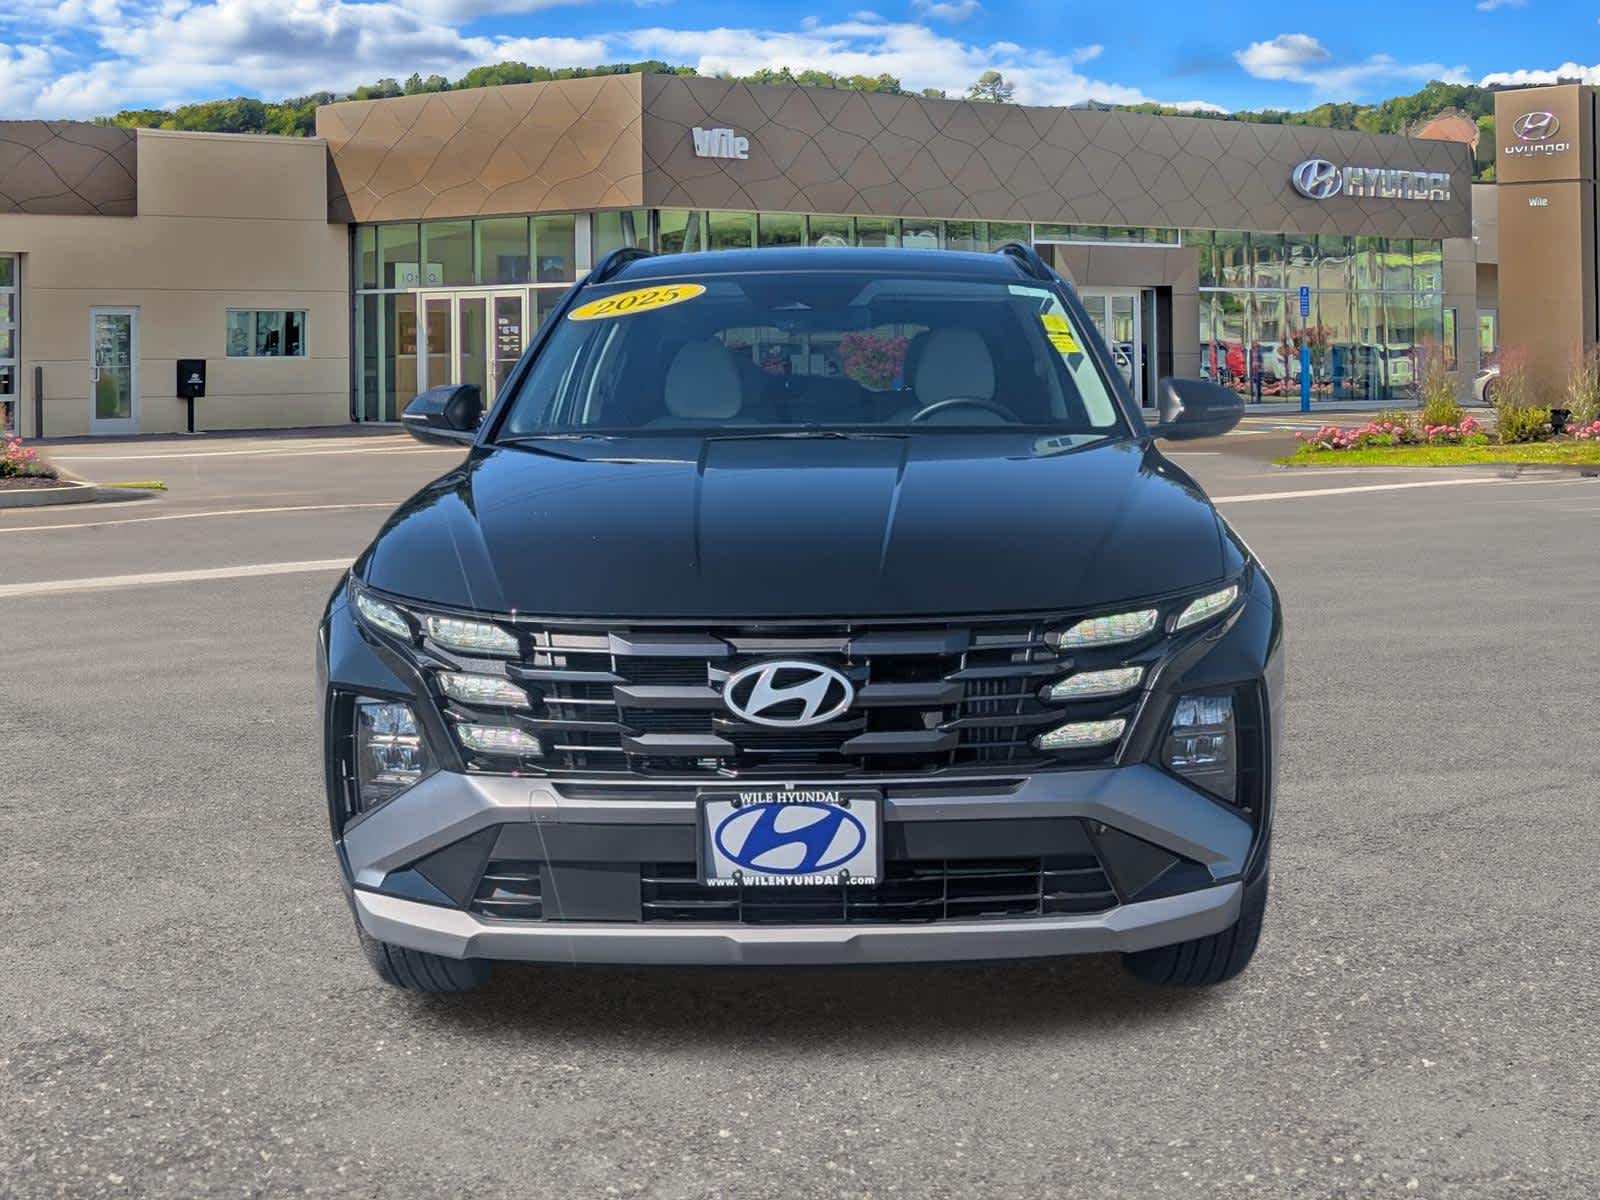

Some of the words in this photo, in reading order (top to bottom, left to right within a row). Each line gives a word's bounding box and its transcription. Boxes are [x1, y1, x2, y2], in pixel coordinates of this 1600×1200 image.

[691, 126, 749, 160] Wile
[1342, 166, 1451, 201] HYUNDAI
[1528, 196, 1549, 207] Wile
[592, 287, 681, 316] 2025
[739, 792, 774, 804] WILE
[776, 791, 840, 803] HYUNDAI
